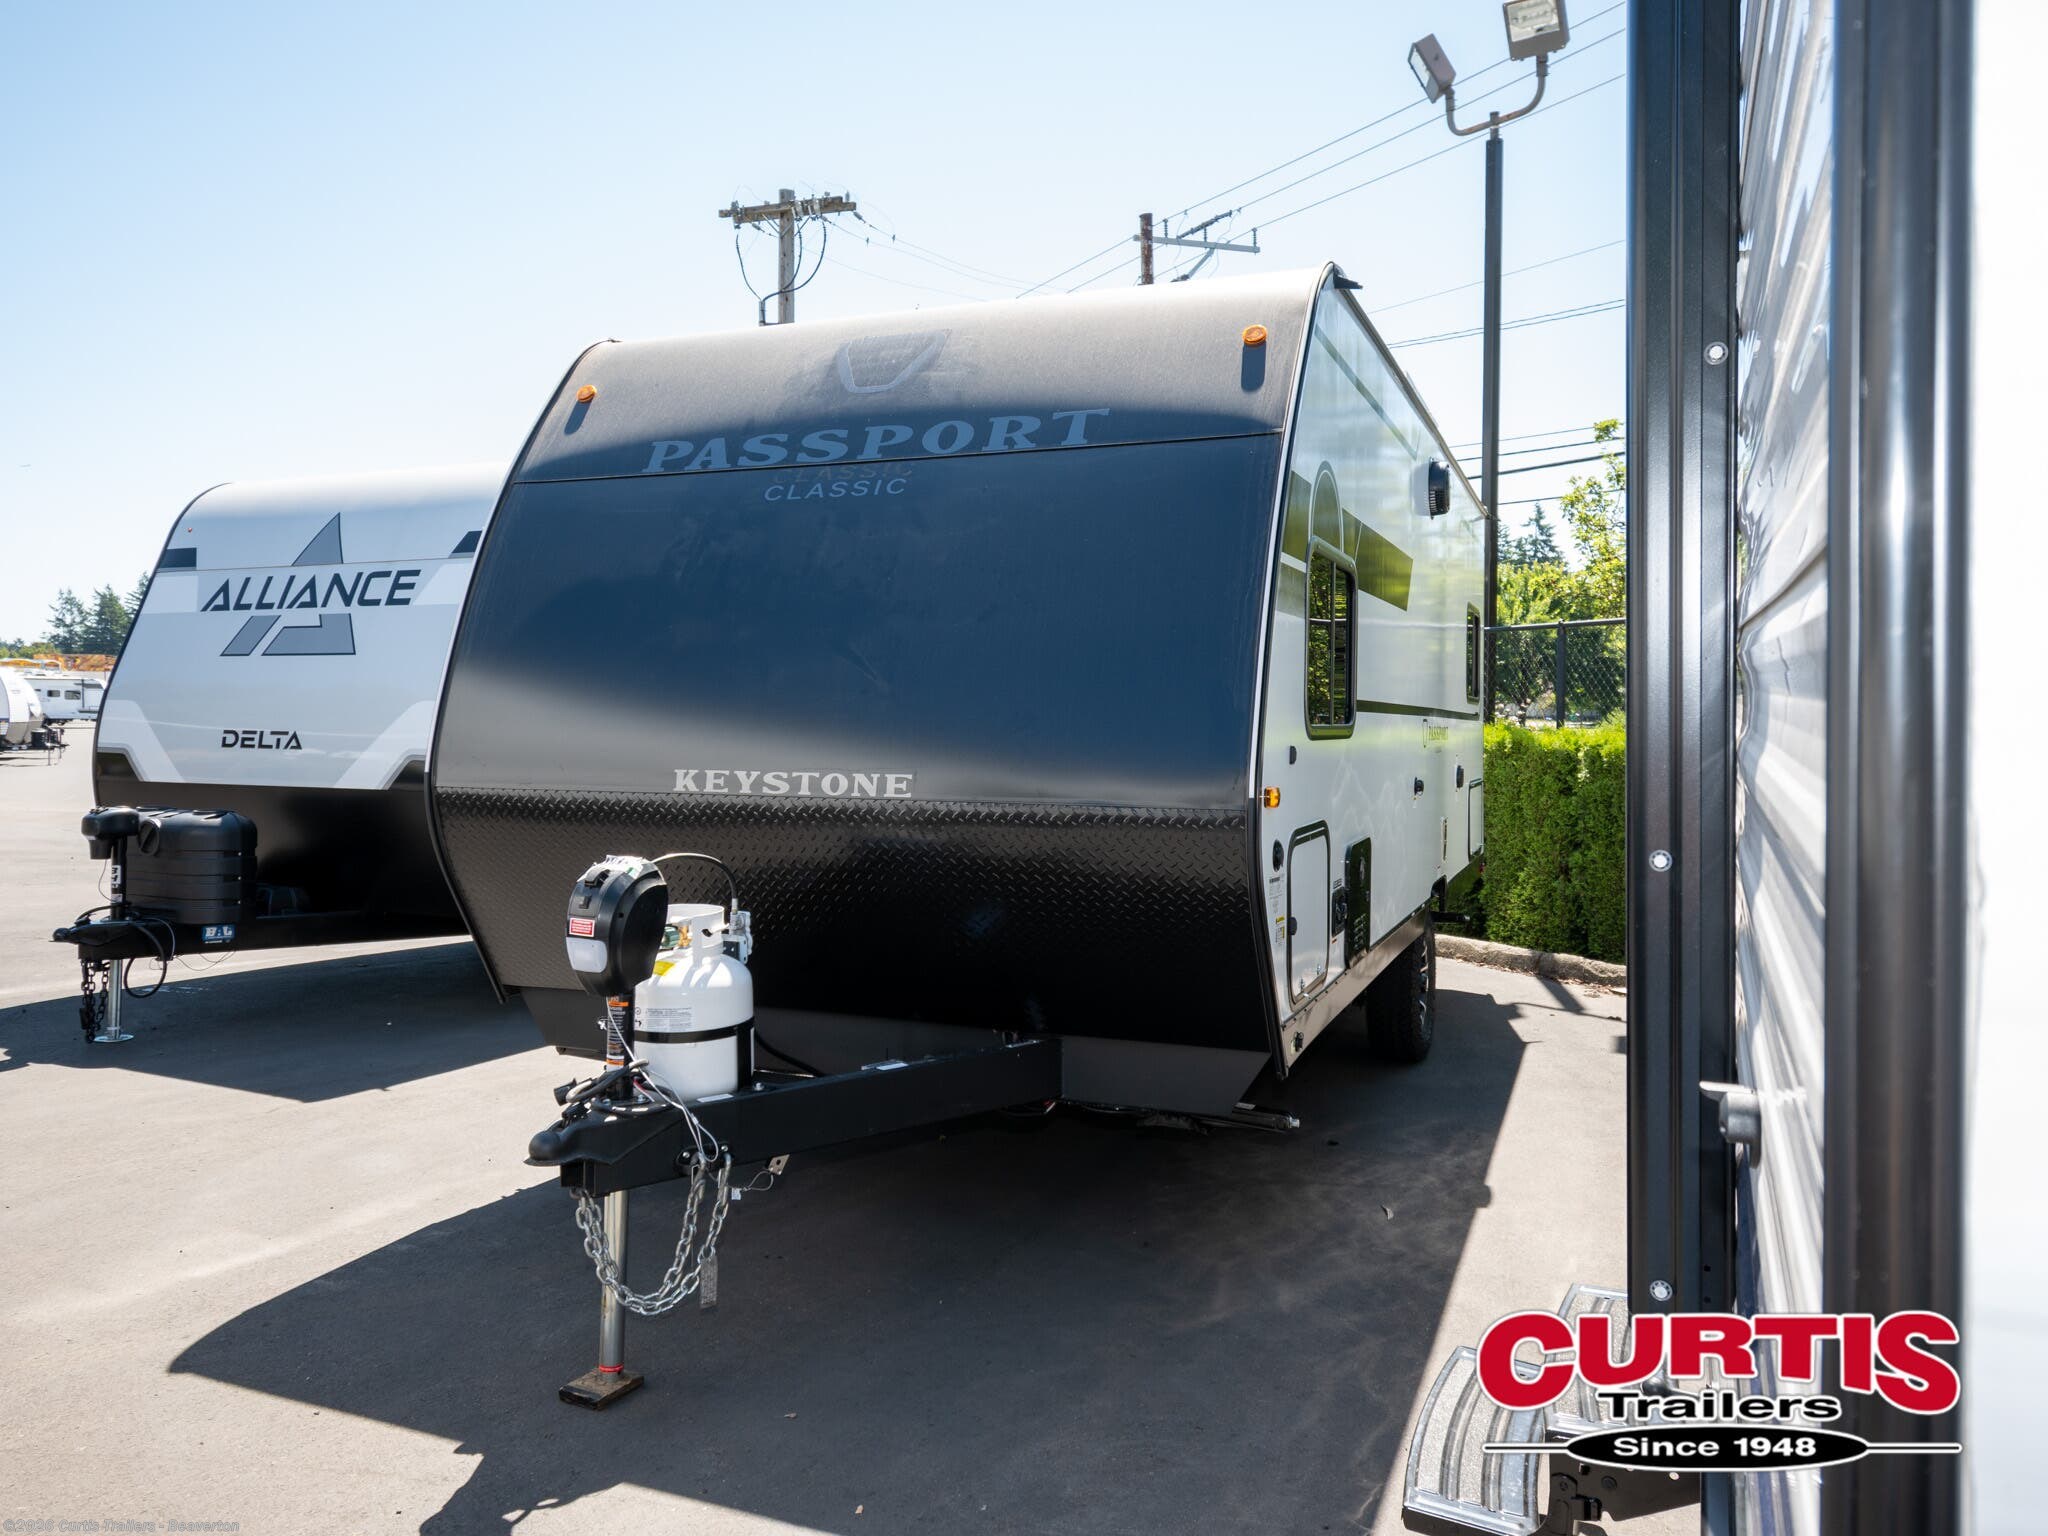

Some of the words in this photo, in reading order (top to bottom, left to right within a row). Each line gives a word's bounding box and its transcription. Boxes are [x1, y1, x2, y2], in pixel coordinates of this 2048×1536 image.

[642, 407, 1111, 474] PASSPORT
[764, 477, 907, 501] CLASSIC
[201, 569, 422, 613] ALLIANCE
[221, 729, 303, 750] DELTA
[672, 768, 914, 798] KEYSTONE
